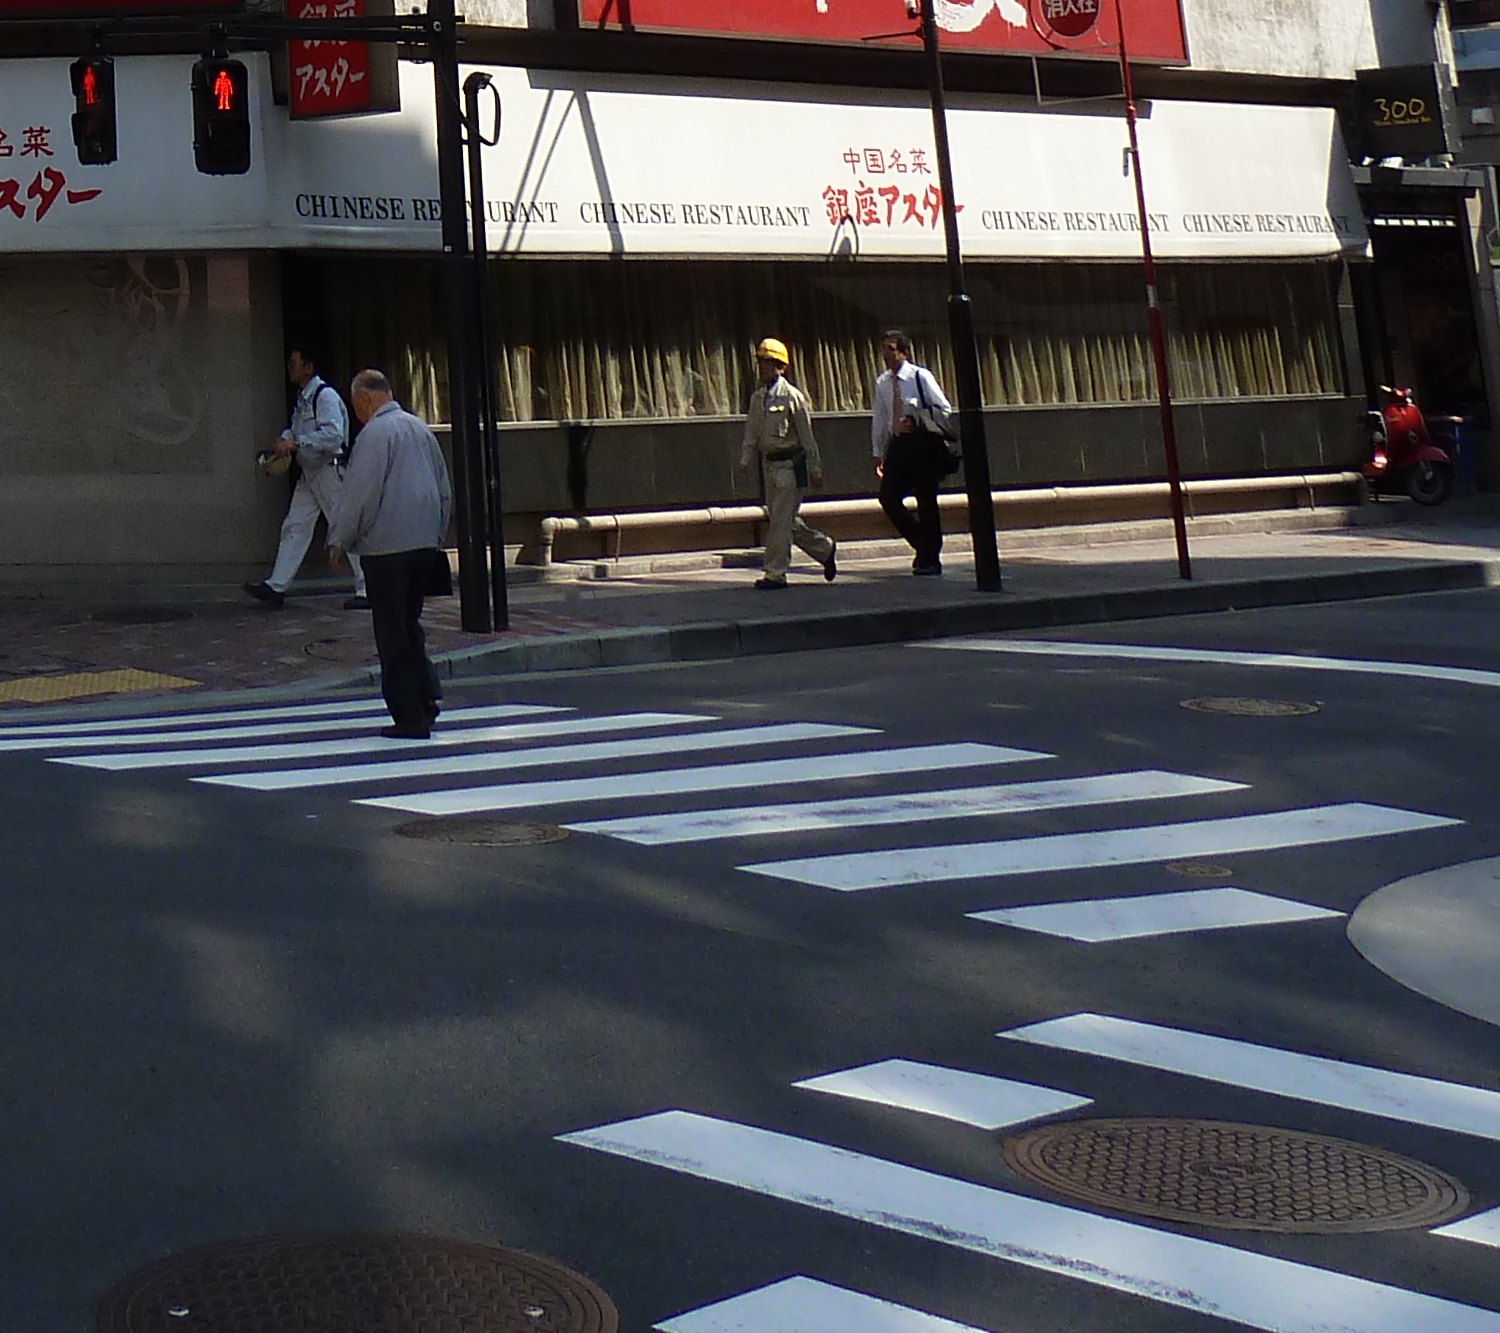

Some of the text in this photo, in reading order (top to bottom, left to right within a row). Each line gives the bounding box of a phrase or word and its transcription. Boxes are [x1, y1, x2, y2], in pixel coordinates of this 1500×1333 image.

[296, 56, 366, 101] アスター
[1374, 97, 1425, 122] 300
[843, 147, 931, 176] 中国名菜
[295, 192, 559, 225] CHINESE REURANT
[580, 201, 811, 227] CHINESE RESTAURANT
[981, 208, 1060, 232] CHINESE
[1183, 212, 1351, 234] CHINESE RESTAURANT
